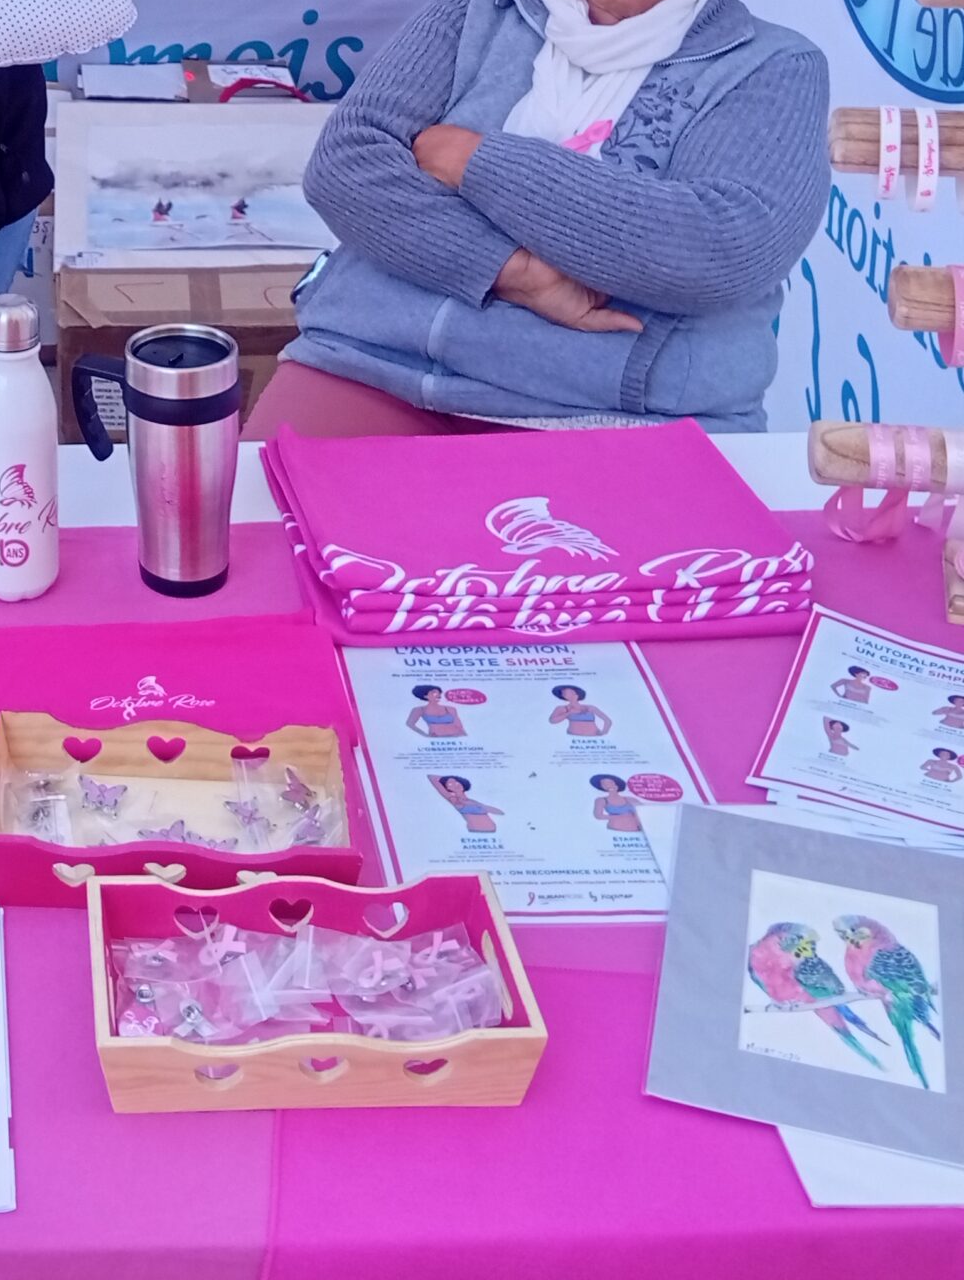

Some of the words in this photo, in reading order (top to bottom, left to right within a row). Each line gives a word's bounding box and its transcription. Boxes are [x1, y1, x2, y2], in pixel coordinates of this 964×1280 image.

[6, 548, 24, 558] ANS
[395, 645, 576, 655] L'AUTOPALPATION,
[404, 658, 430, 667] UN
[438, 658, 500, 667] GESTE
[505, 657, 575, 666] SIMPLE
[856, 646, 875, 658] UN
[879, 655, 924, 674] GESTE
[90, 696, 164, 720] Octobre
[168, 694, 215, 709] Rose
